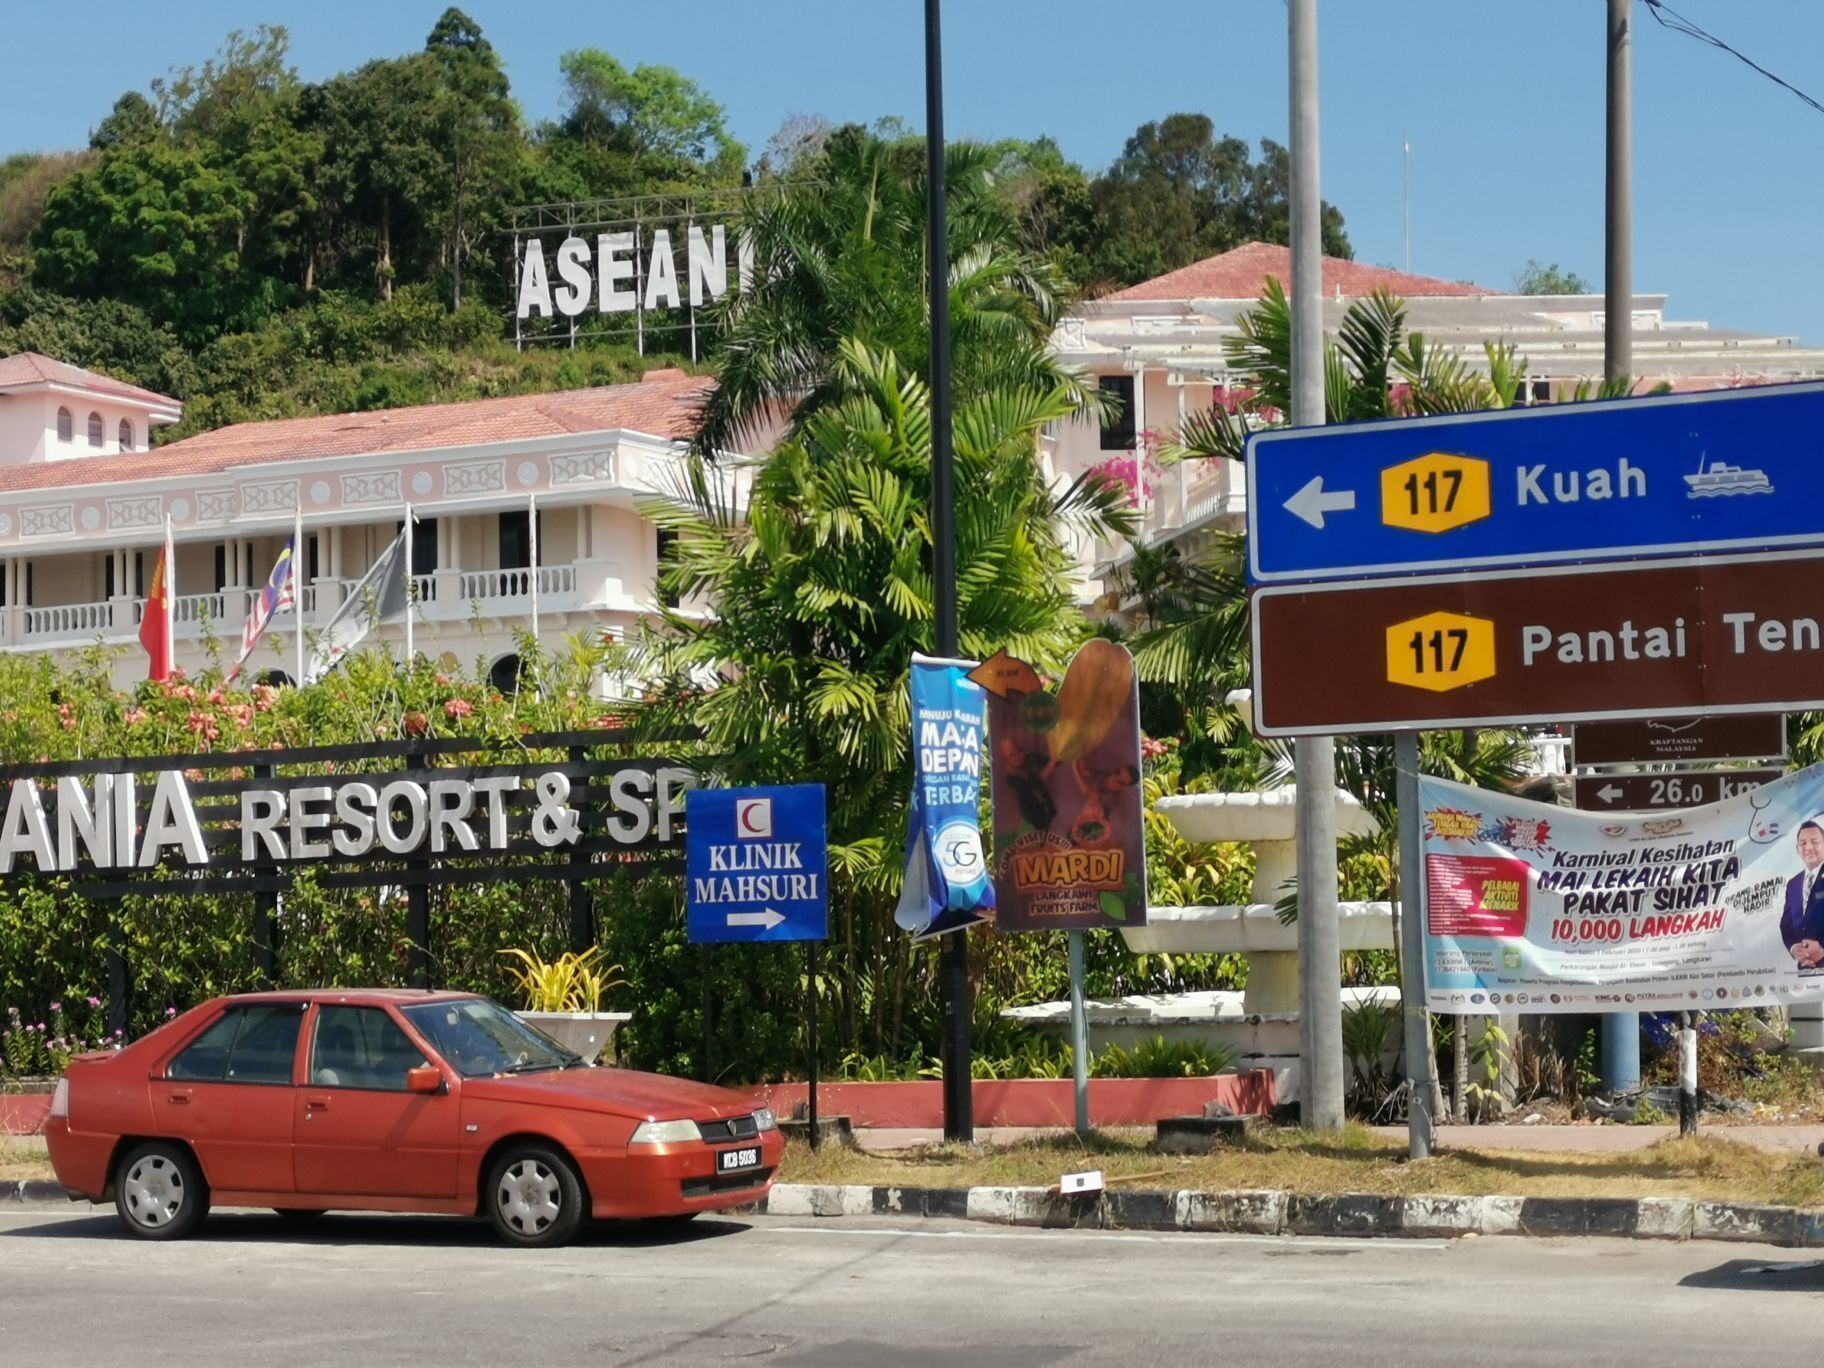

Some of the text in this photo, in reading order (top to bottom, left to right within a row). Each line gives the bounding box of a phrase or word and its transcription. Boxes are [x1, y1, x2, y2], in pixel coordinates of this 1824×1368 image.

[1404, 457, 1647, 515] 117 Kuah
[1409, 629, 1469, 674] 117
[1522, 617, 1686, 667] Pantai
[1650, 778, 1703, 804] 26.0
[0, 769, 209, 873] ANIA
[241, 774, 520, 862] RESORT
[531, 771, 583, 847] &
[709, 842, 803, 872] KLINIK
[1015, 851, 1121, 887] MARDI
[1552, 839, 1735, 868] Karnival Kesihatan
[694, 873, 819, 904] MAHSURI
[1537, 856, 1741, 891] MAI LEKAIH KITA
[1030, 902, 1099, 914] FRUITS FARM
[1563, 882, 1727, 916] PAKAT SIHAT
[1551, 908, 1726, 943] 10,000 LANGKAH
